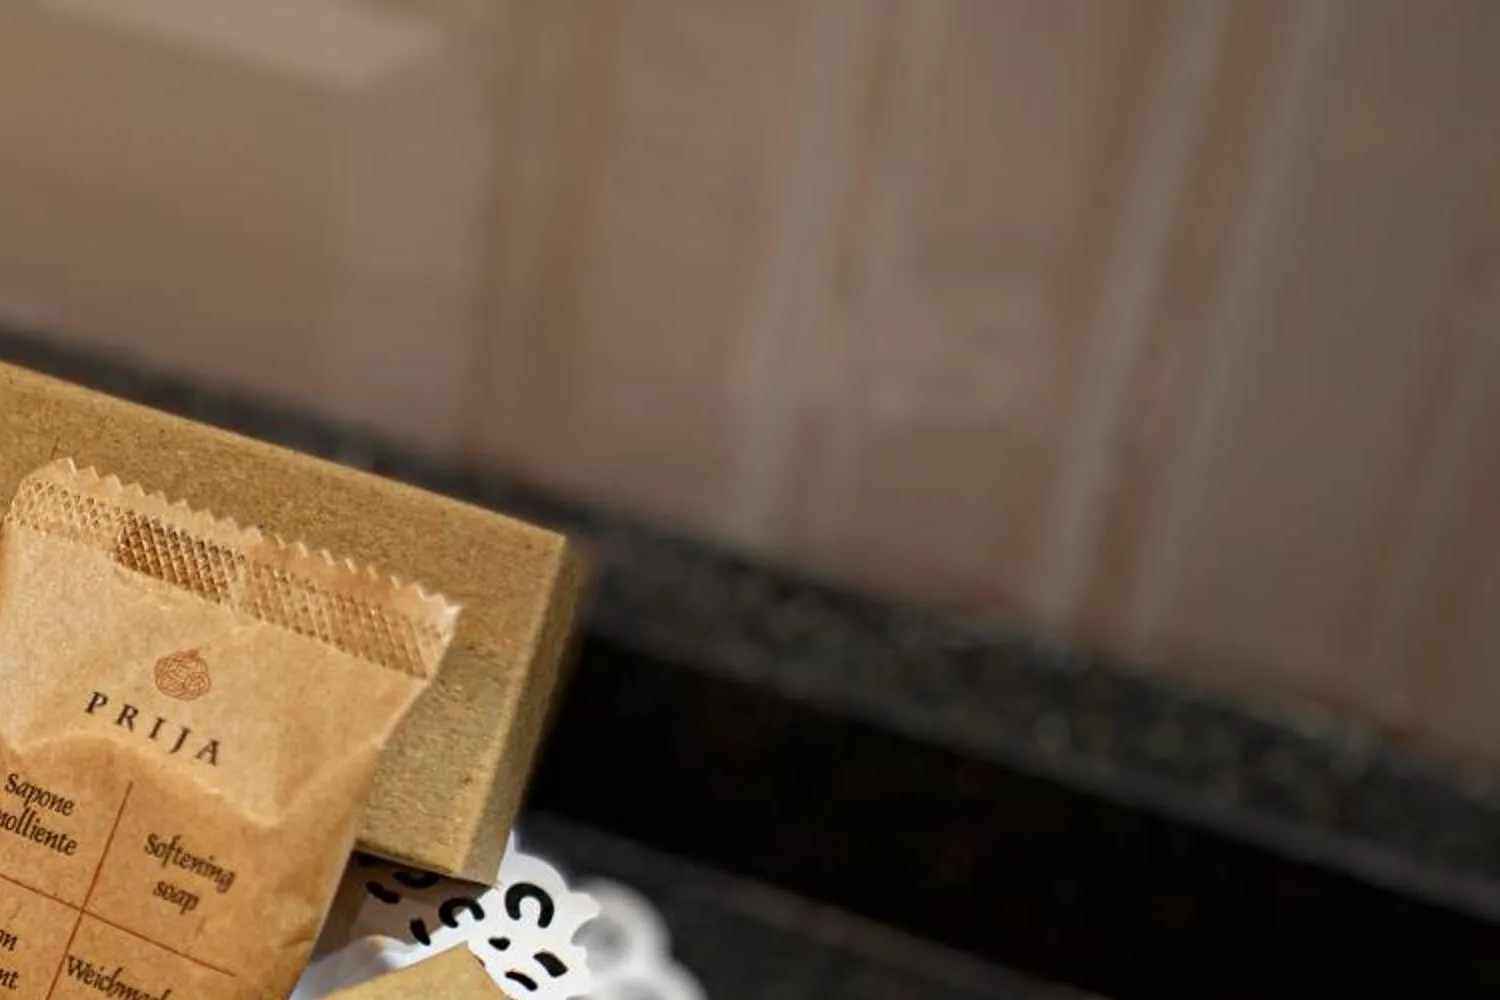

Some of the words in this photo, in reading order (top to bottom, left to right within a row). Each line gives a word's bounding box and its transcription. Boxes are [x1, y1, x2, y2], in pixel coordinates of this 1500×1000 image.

[84, 691, 220, 767] PRIJA
[4, 773, 75, 816] Sapone
[144, 833, 236, 894] Softening
[153, 880, 200, 915] soap
